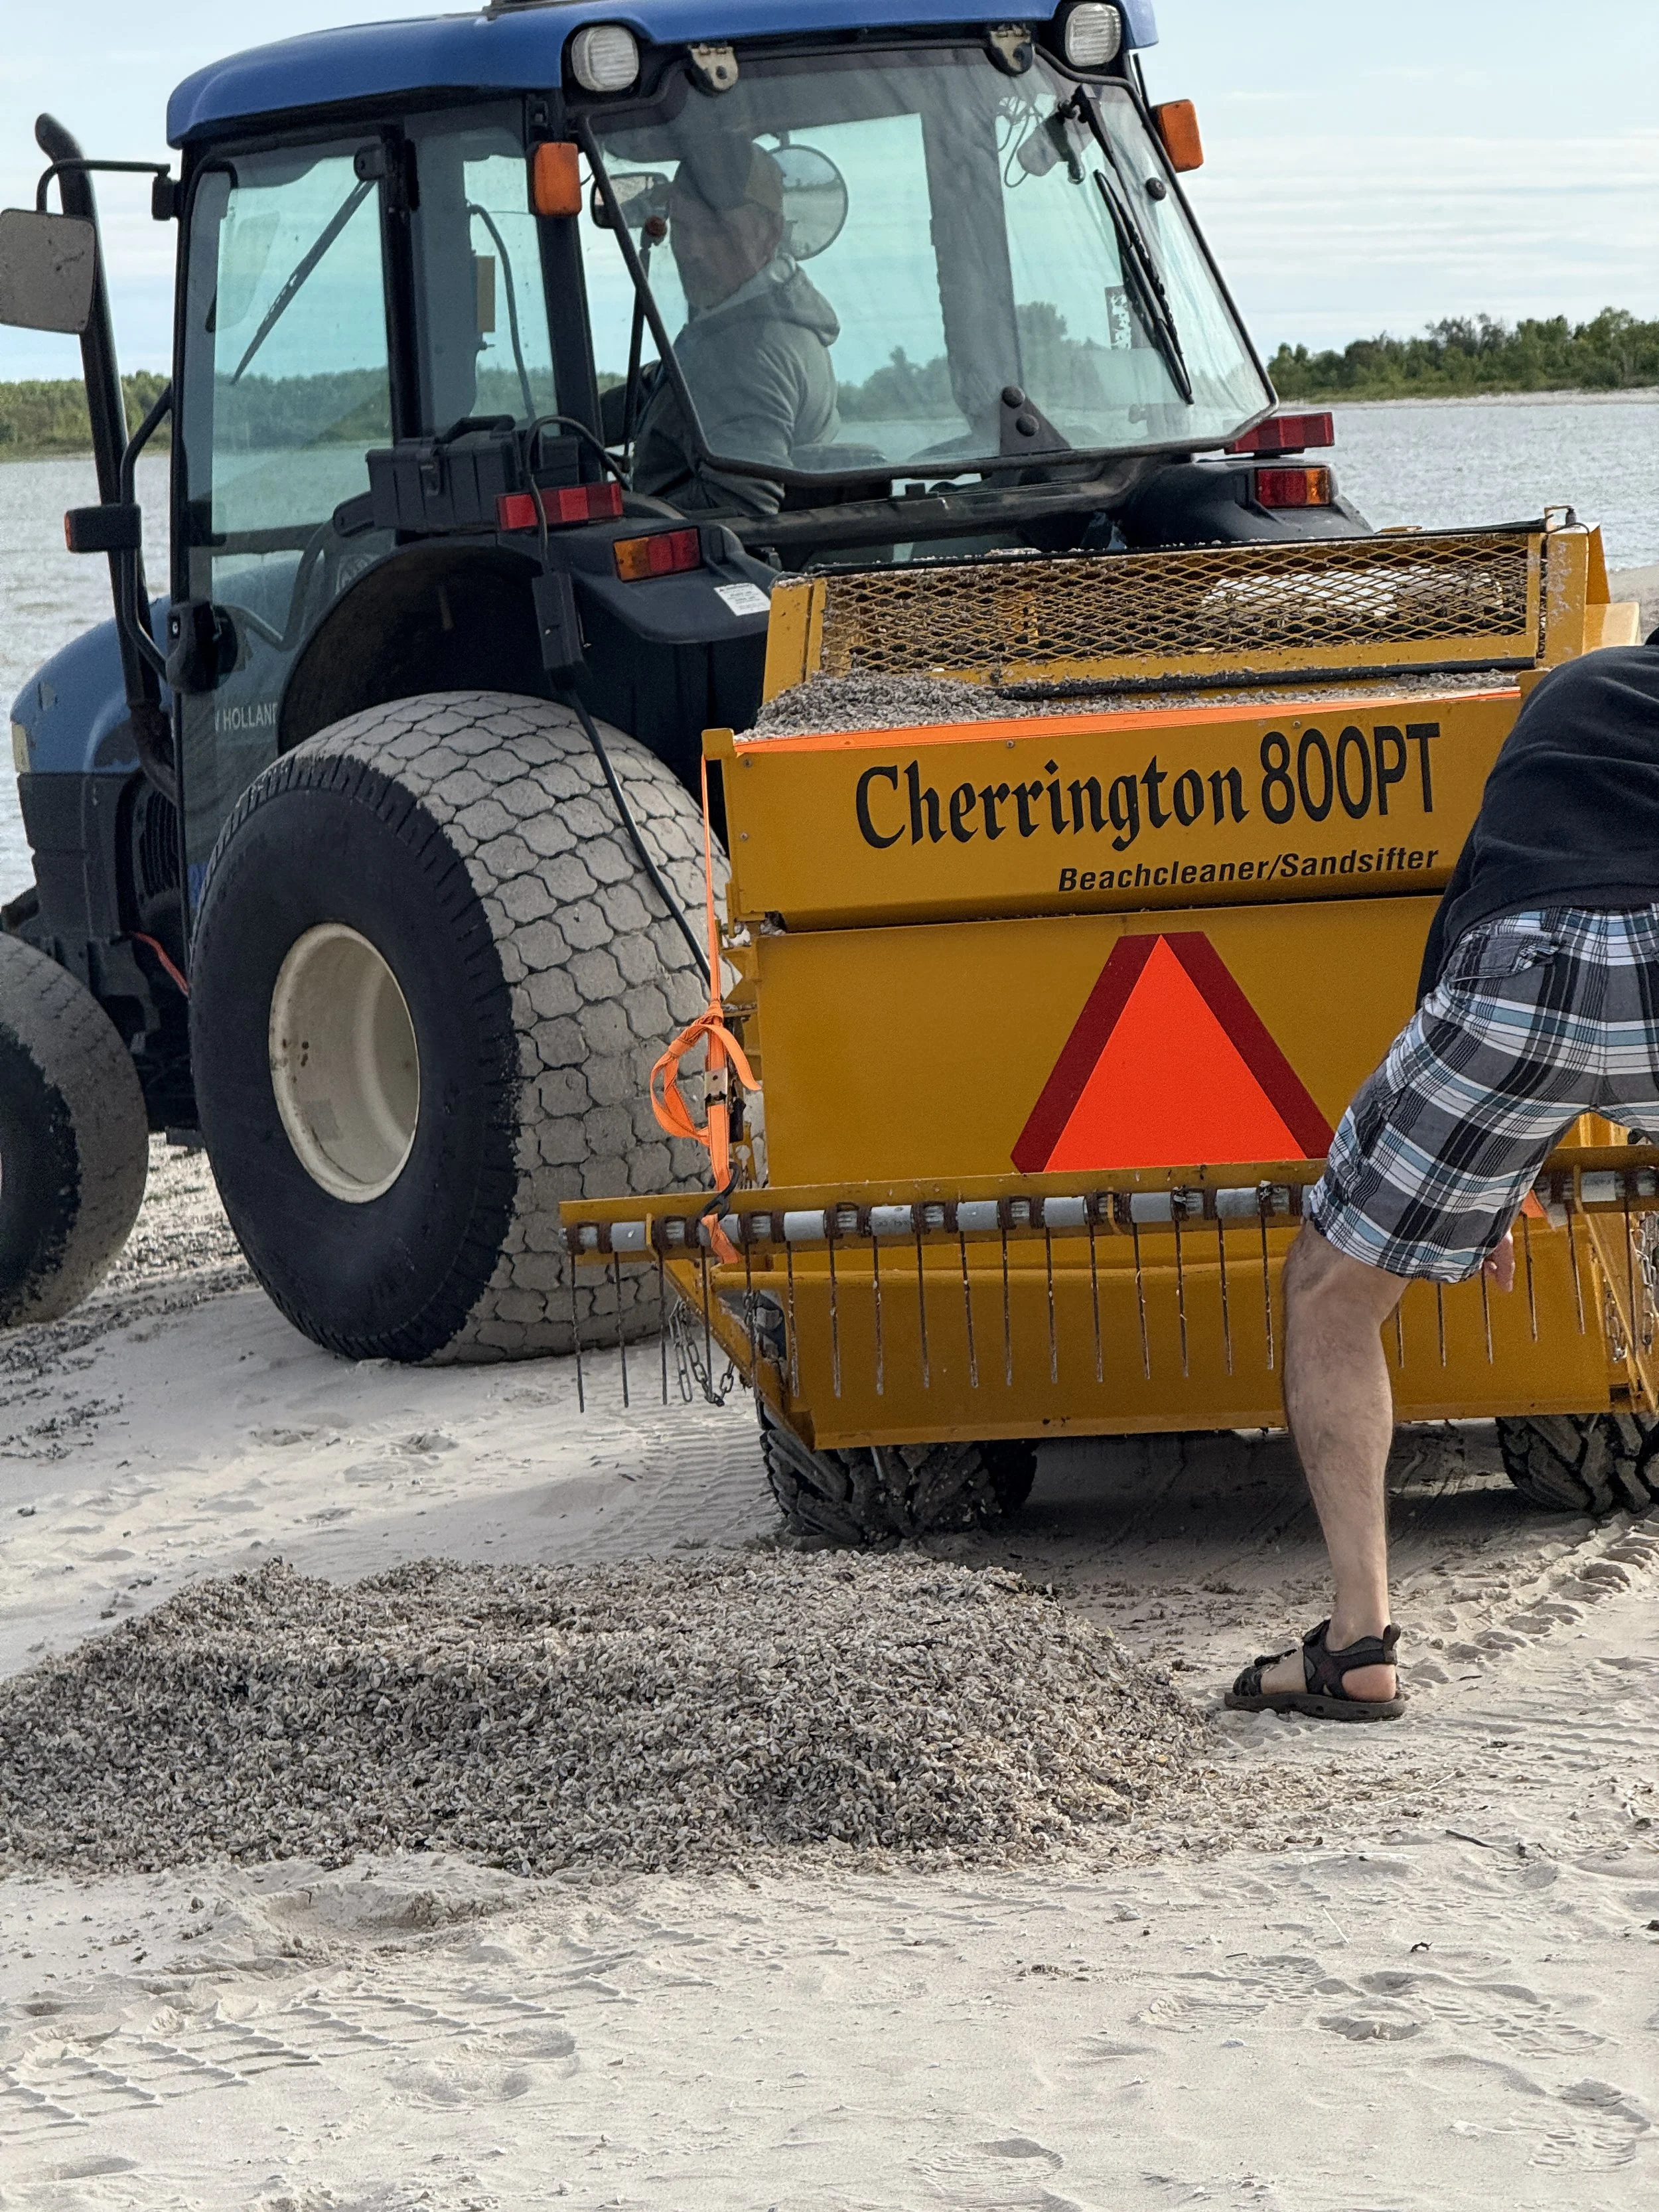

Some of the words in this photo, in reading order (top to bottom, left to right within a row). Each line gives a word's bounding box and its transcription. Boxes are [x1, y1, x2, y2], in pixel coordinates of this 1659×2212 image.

[855, 755, 1251, 852] Cherrington
[1260, 722, 1441, 825] 800PT
[1058, 847, 1439, 893] Beachcleaner/Sandsifter
